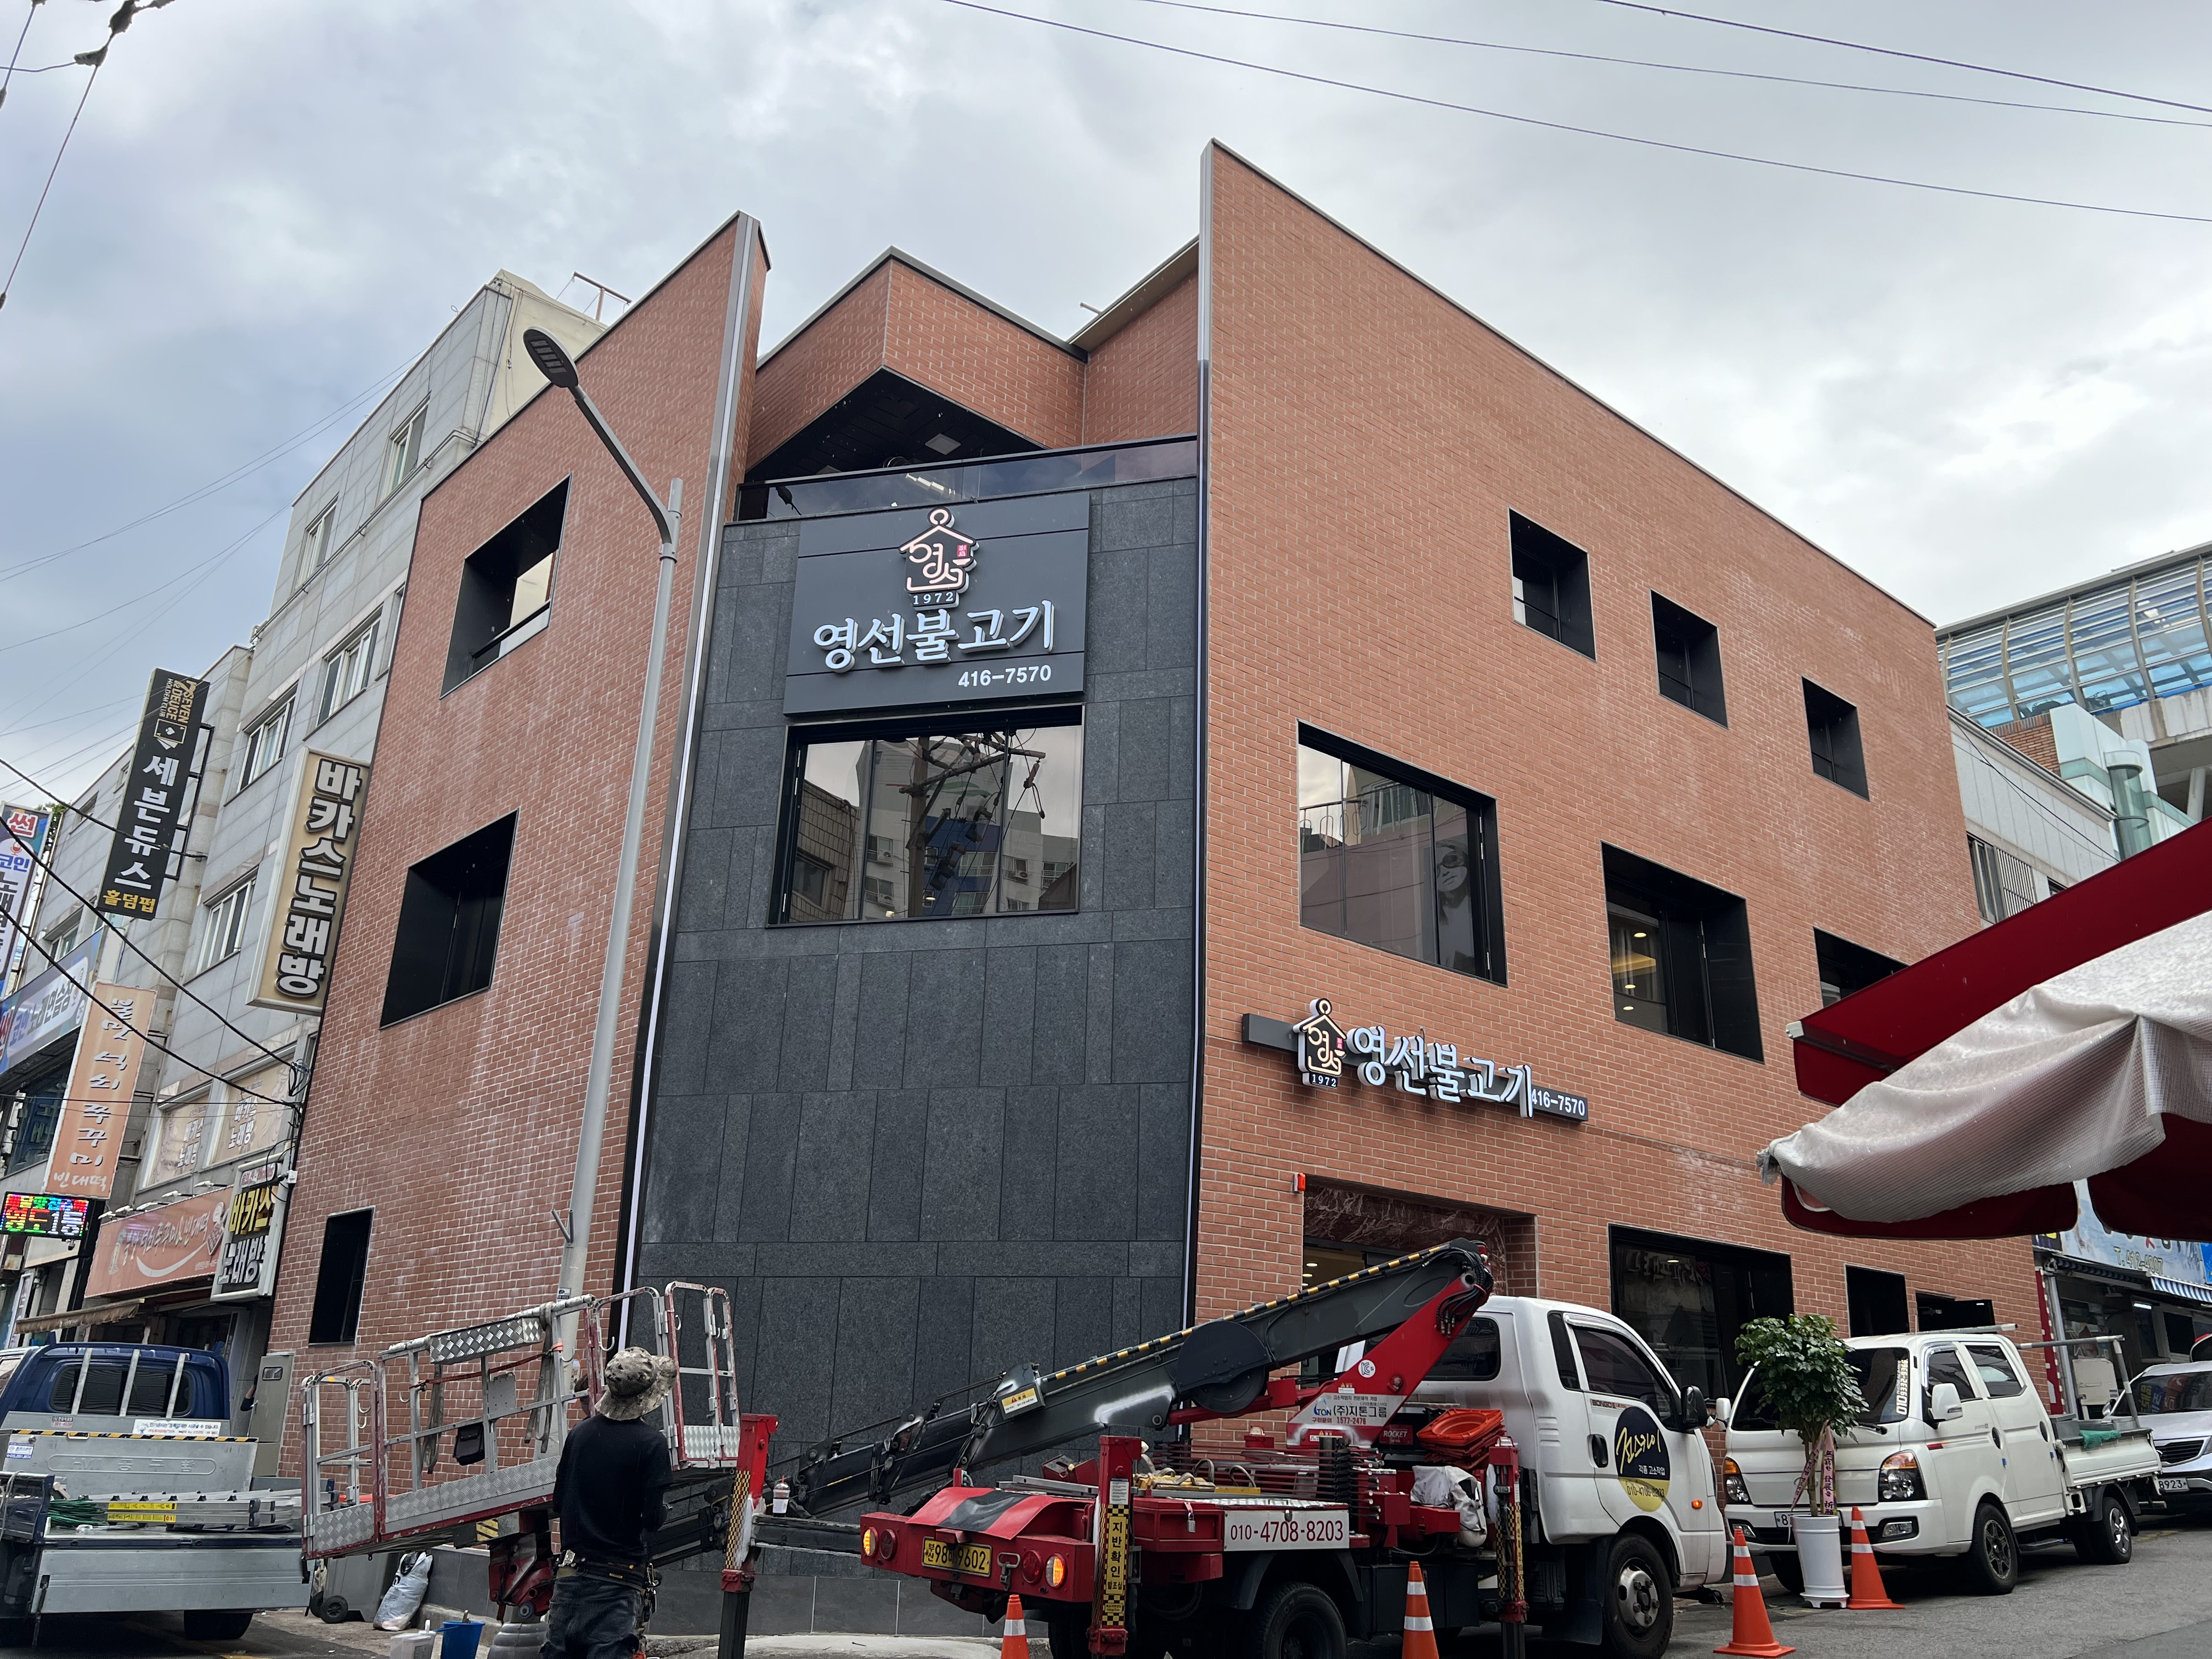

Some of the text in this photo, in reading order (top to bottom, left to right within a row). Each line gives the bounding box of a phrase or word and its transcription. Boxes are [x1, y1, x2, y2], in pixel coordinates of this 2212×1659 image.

[913, 591, 953, 605] 1972
[814, 600, 1054, 672] 영선불고기
[958, 664, 1052, 687] 416-7570
[162, 678, 174, 702] HOLDEM
[165, 689, 183, 721] DEUCE
[177, 691, 194, 724] SEVEN
[9, 812, 36, 836] 썬
[114, 755, 179, 890] 세븐듀스
[0, 854, 30, 872] 코인
[276, 758, 362, 997] 바카스노래방
[103, 889, 156, 913] 홀덤펍
[1312, 1074, 1337, 1087] 1972
[1347, 1025, 1534, 1118] 영선불고기
[234, 1095, 258, 1122] 바카스
[1532, 1088, 1585, 1116] 416-7570
[70, 1103, 111, 1166] 쭈꾸미
[228, 1119, 256, 1149] 노래방
[54, 1172, 108, 1192] 빈대떡
[228, 1187, 271, 1235] 바카스
[217, 1235, 264, 1285] 노래방
[1333, 1405, 1387, 1418] (주)지톤그룹
[1638, 1465, 1648, 1475] 각종
[1231, 1520, 1344, 1543] 010-4708-8203
[1110, 1522, 1122, 1578] 지반확인
